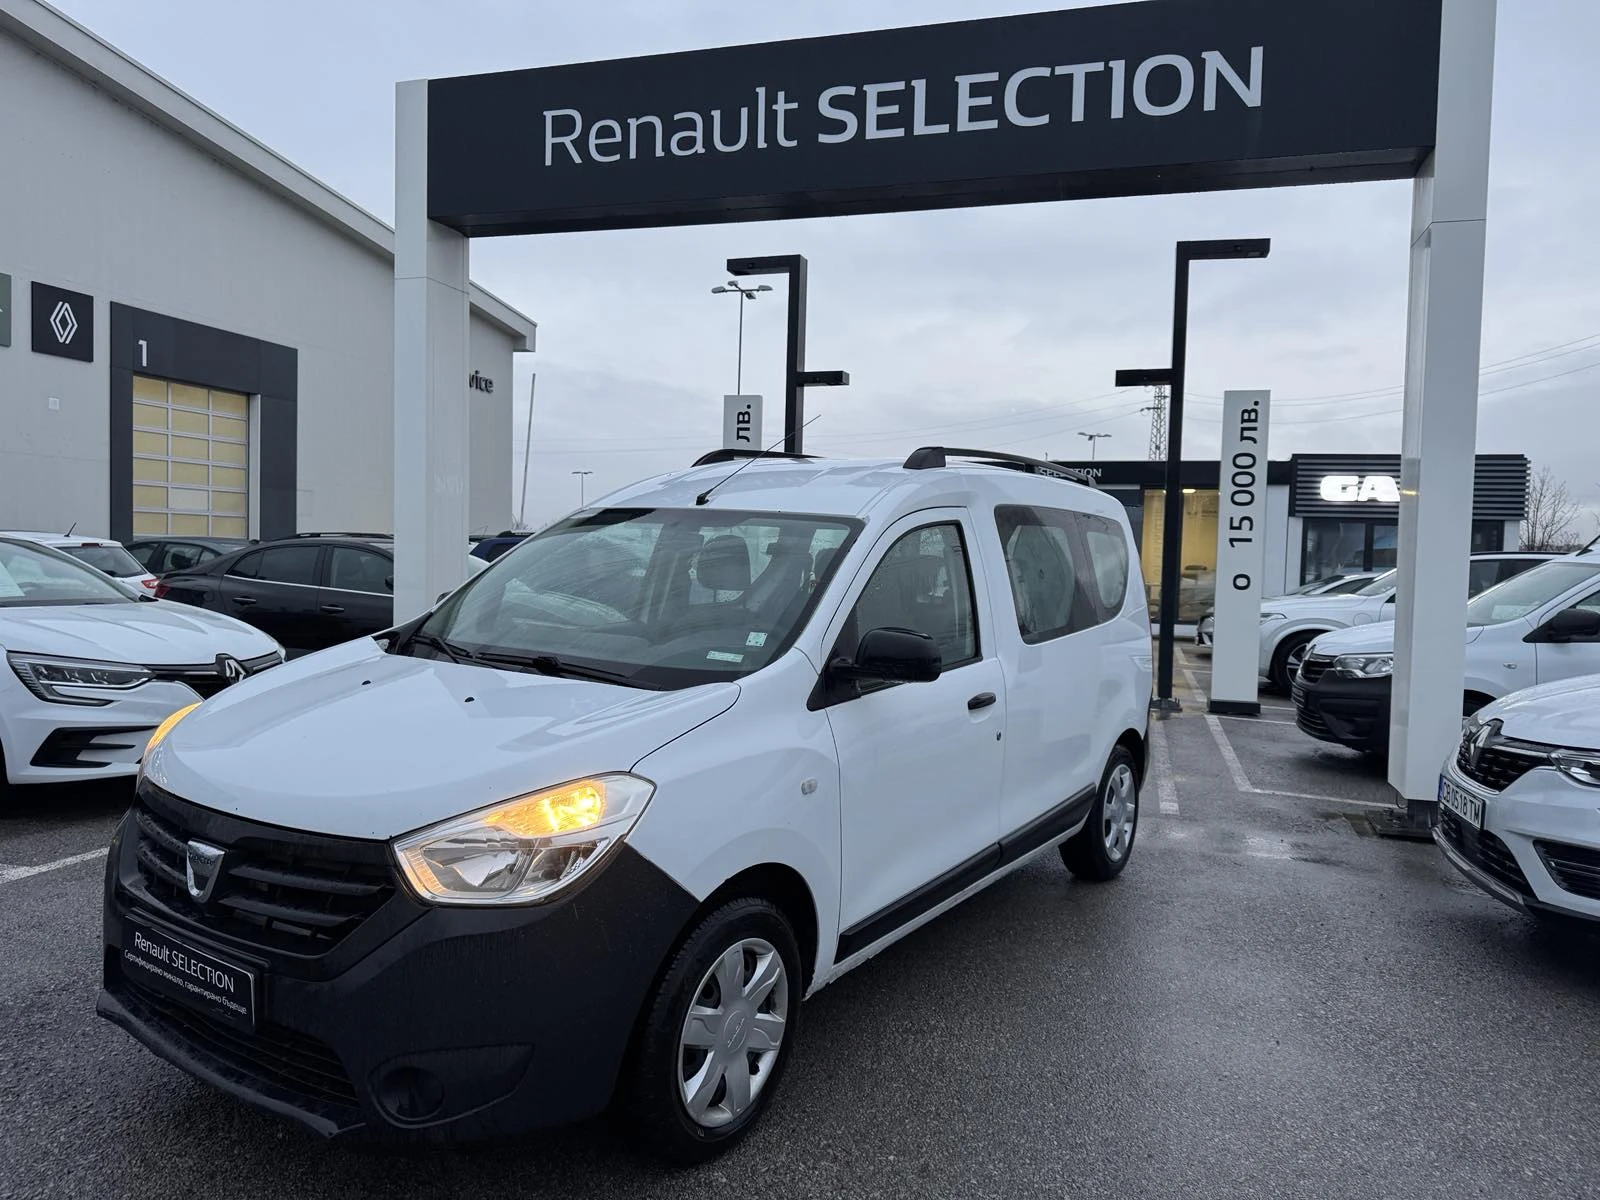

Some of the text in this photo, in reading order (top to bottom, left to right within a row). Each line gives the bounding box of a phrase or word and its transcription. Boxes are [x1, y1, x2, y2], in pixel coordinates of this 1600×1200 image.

[543, 45, 1265, 167] Renault SELECTION
[138, 339, 147, 367] 1
[1239, 400, 1260, 444] лв.
[1230, 452, 1257, 507] 000
[1229, 516, 1254, 548] 15
[134, 931, 234, 993] Renault SELECTION
